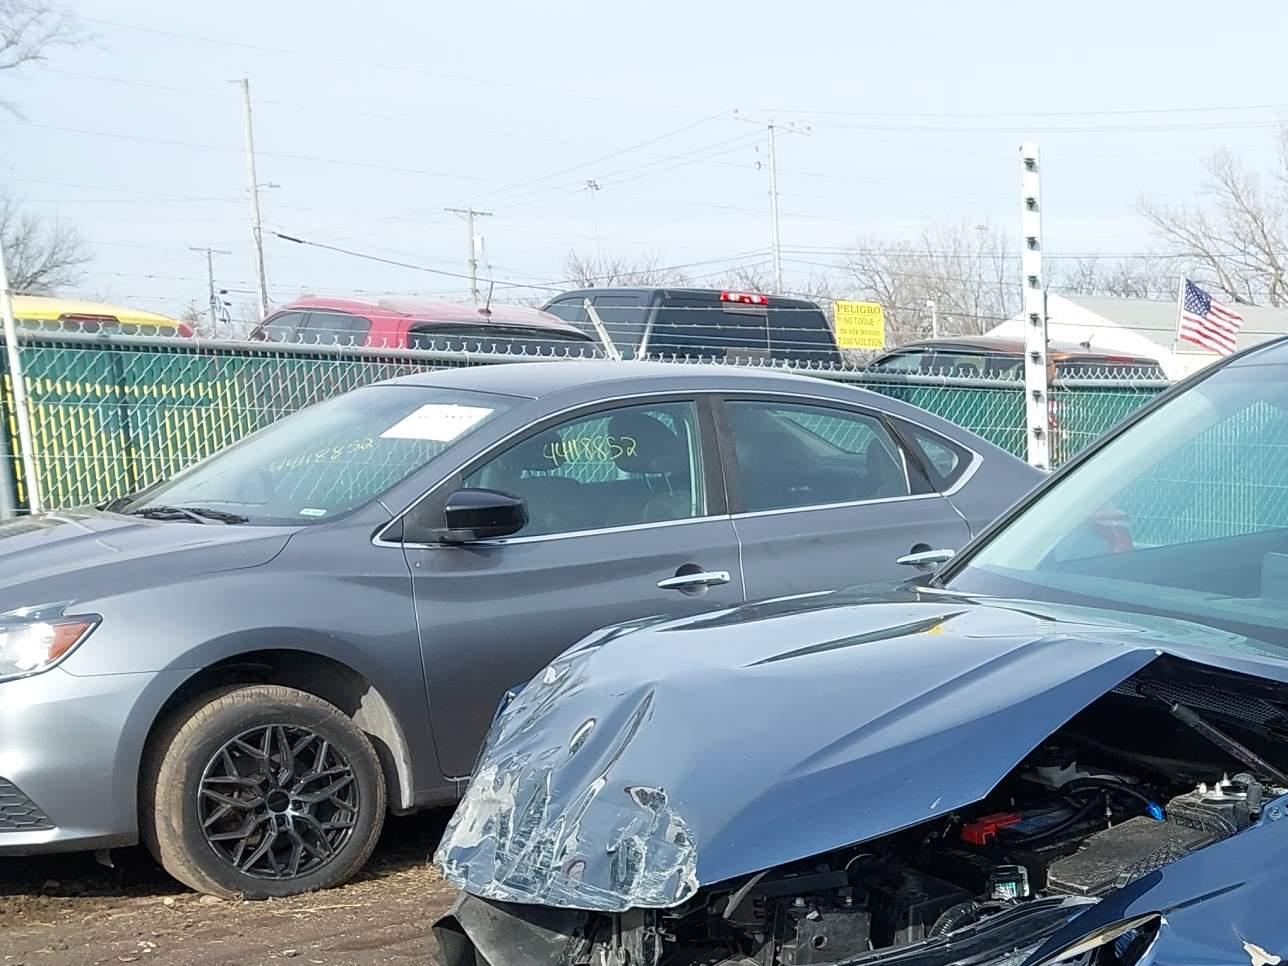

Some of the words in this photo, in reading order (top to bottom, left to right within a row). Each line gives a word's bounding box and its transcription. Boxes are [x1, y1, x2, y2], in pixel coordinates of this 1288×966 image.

[837, 303, 881, 315] PELIGRO
[843, 316, 853, 325] NO
[854, 317, 875, 326] TOQUE
[543, 435, 638, 467] 44118852
